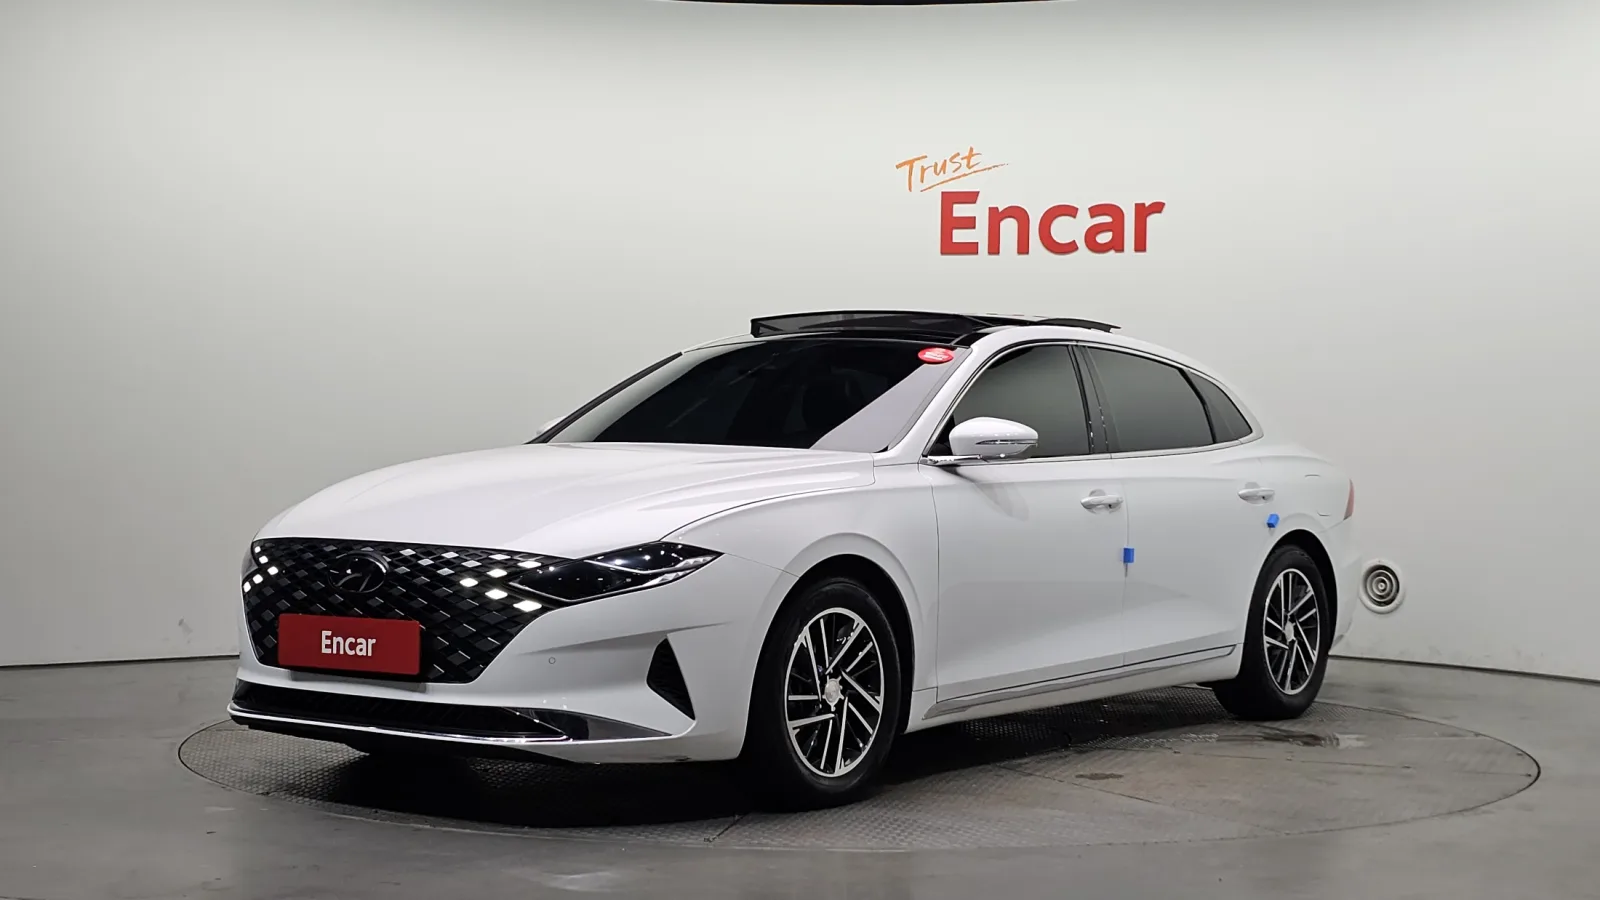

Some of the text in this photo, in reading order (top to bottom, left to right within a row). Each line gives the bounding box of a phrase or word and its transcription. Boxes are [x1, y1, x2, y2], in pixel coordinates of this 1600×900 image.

[895, 146, 982, 192] Trust
[940, 191, 1166, 255] Encar
[321, 630, 376, 656] Encar
